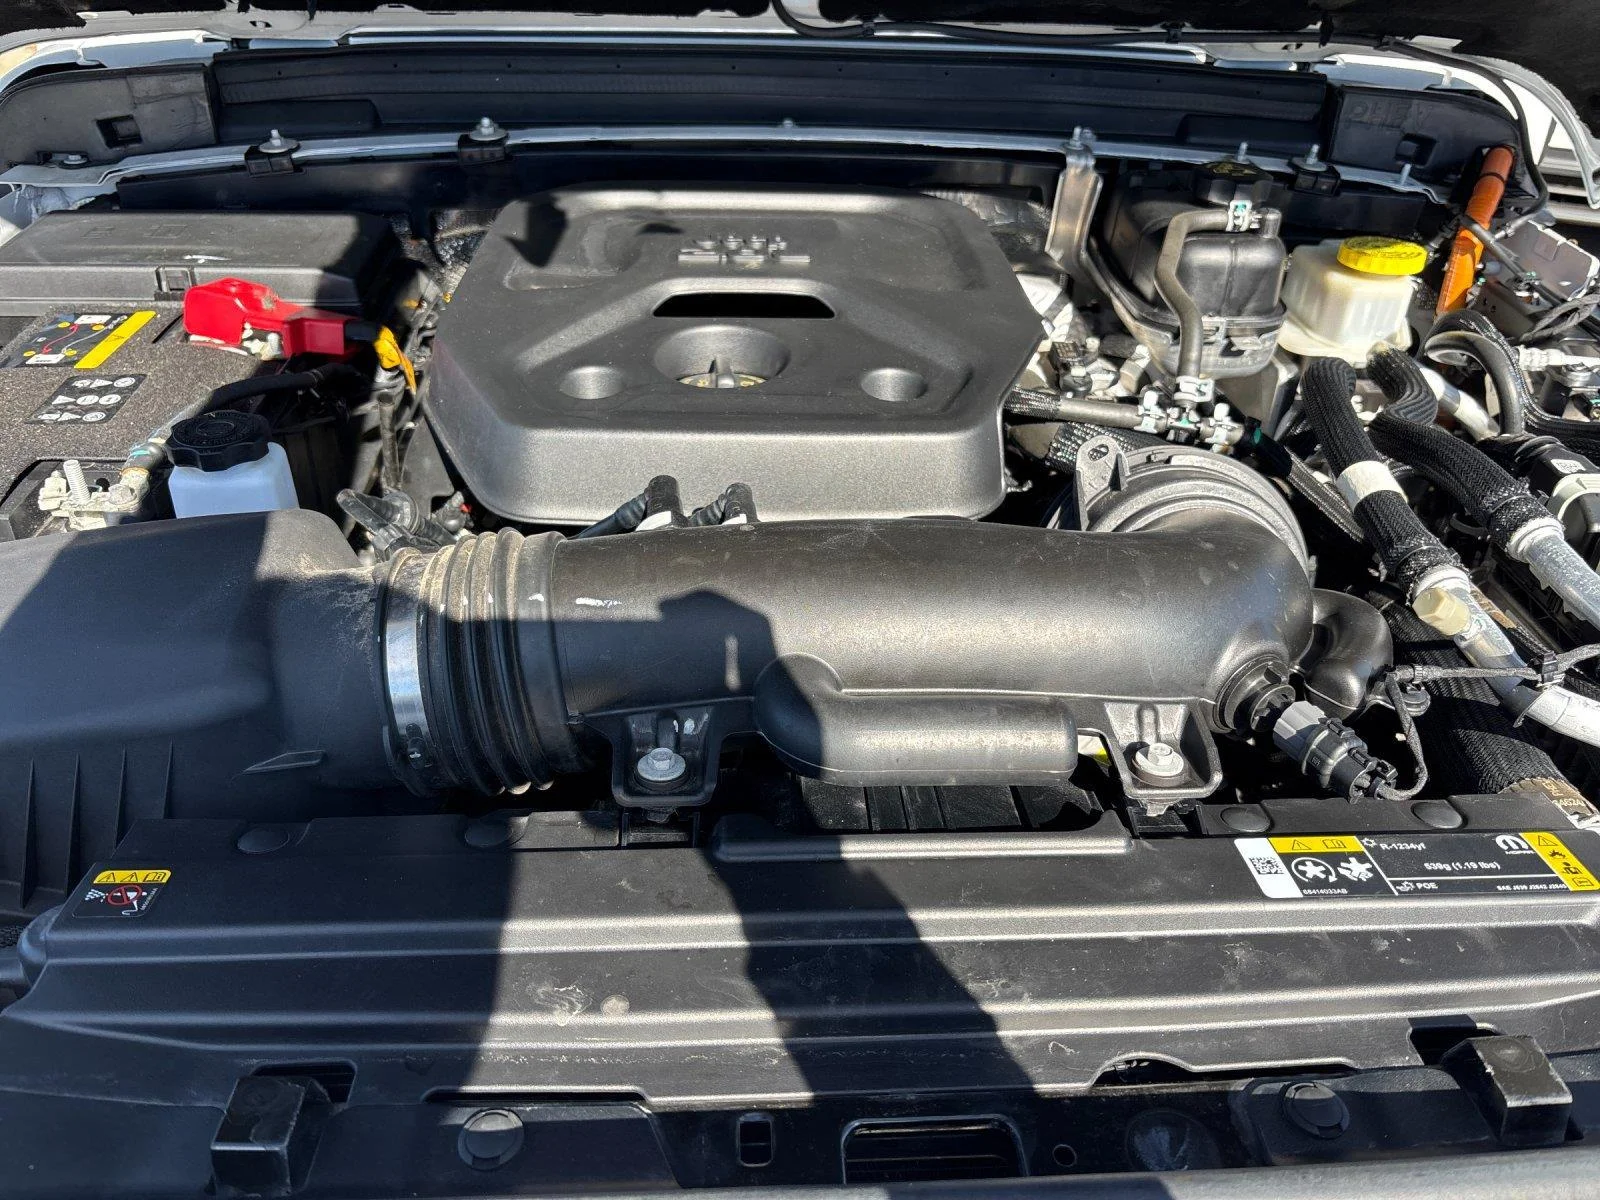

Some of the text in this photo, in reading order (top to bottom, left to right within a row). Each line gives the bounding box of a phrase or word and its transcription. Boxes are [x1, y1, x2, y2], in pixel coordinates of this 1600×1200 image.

[1380, 842, 1426, 851] R-1234yf
[1452, 862, 1478, 870] (1.19
[1416, 882, 1438, 890] POE
